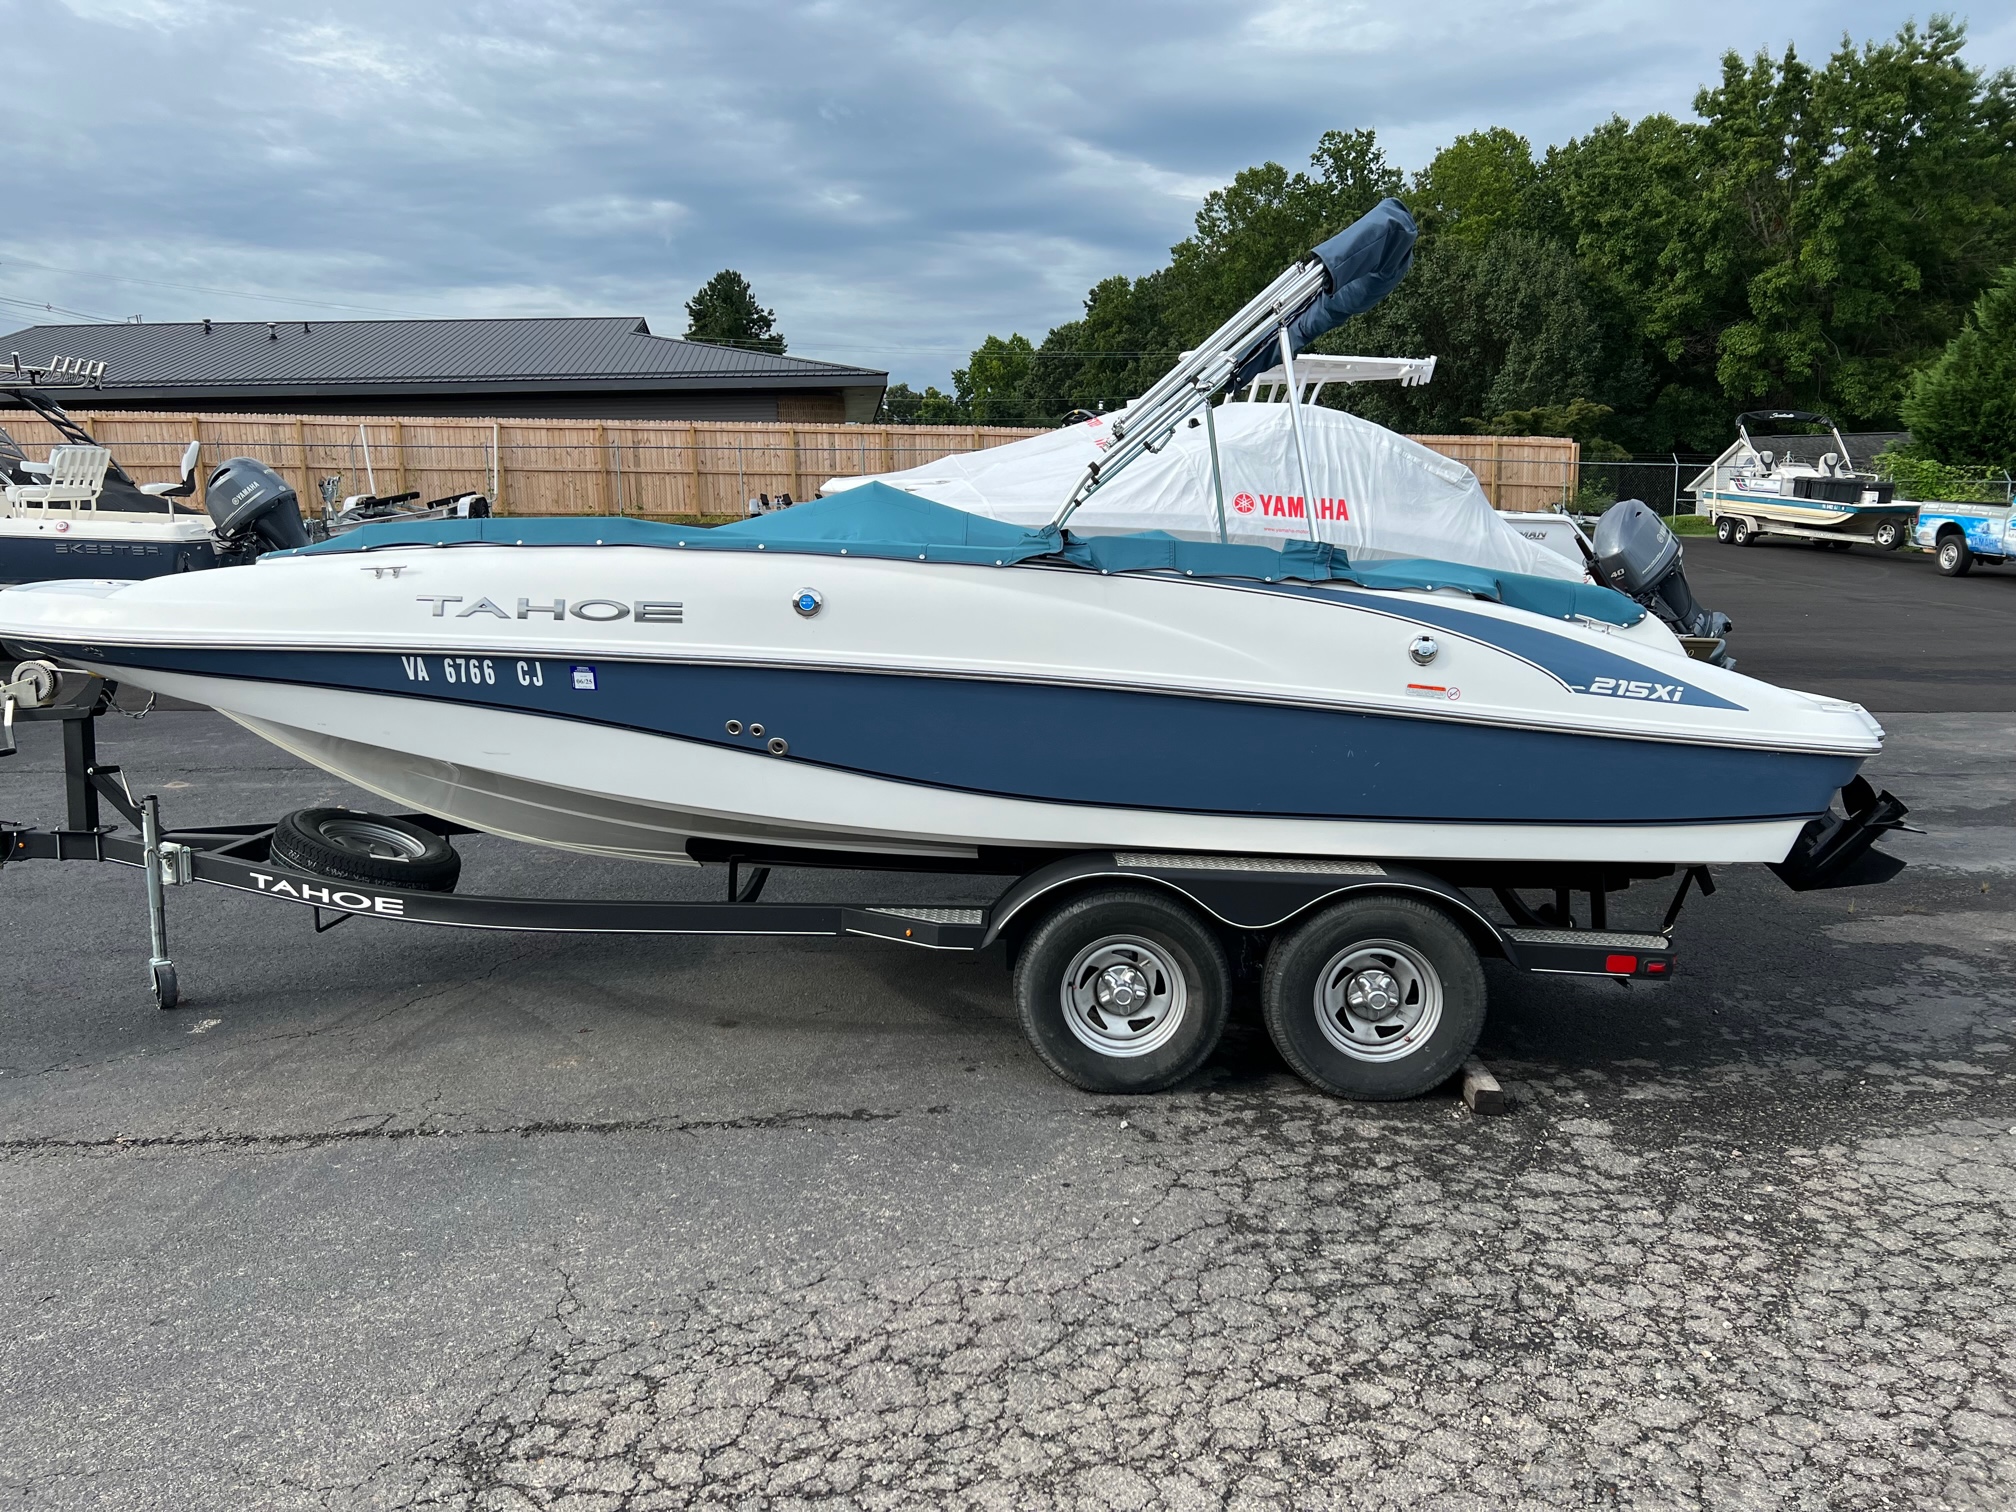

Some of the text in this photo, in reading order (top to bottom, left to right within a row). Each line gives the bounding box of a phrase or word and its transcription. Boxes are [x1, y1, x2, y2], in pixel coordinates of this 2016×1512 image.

[237, 481, 260, 501] YAMAHA
[55, 543, 160, 556] SKEETER
[1969, 536, 1998, 548] YAMAHA
[1611, 568, 1625, 578] 40
[416, 594, 683, 623] TAHOE
[401, 656, 544, 687] VA 6766 CJ
[1589, 676, 1684, 702] 215Xi
[249, 872, 404, 915] TAHOE
